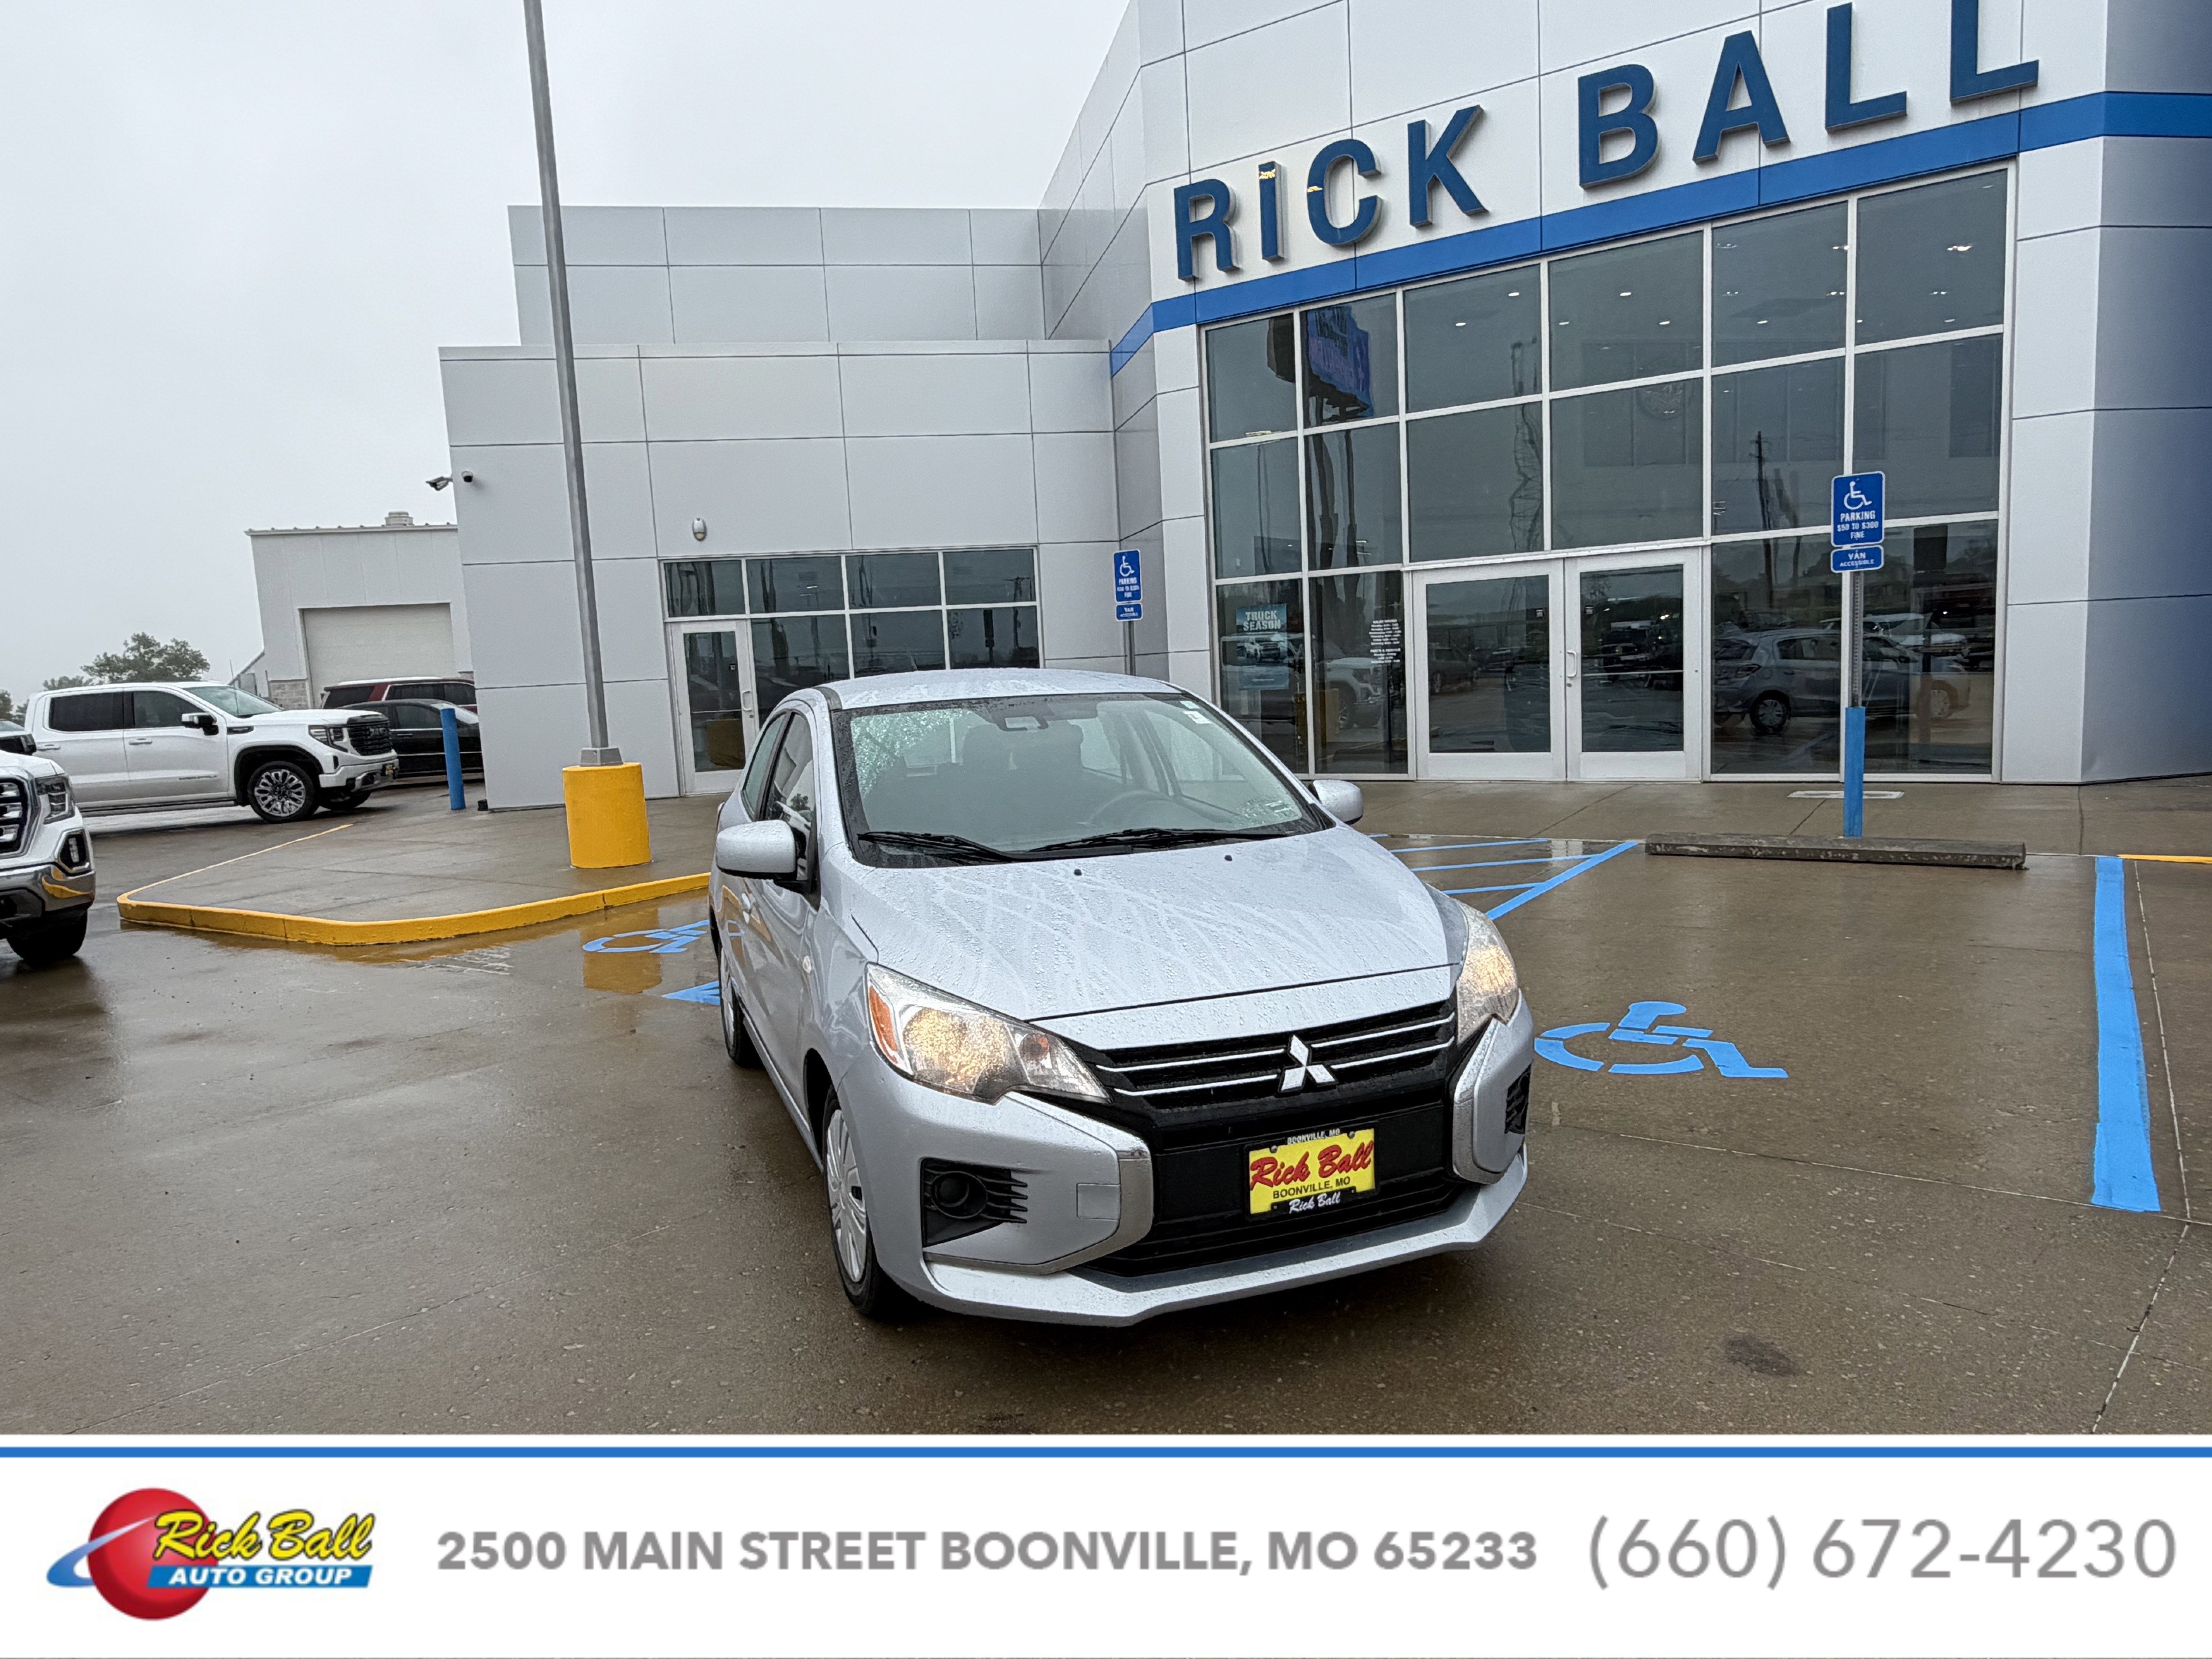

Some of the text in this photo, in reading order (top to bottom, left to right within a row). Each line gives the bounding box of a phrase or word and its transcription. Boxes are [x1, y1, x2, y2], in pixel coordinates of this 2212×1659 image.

[1173, 0, 2039, 280] RICK BALL
[1840, 510, 1875, 522] PARKING
[1837, 524, 1850, 532] $50
[1862, 521, 1879, 529] $300
[1245, 610, 1277, 621] TRUCK
[1243, 619, 1281, 631] SEASON
[1287, 1128, 1340, 1145] BOONVILLE, MO
[1250, 1140, 1374, 1191] Rick Ball
[1273, 1176, 1350, 1199] BOONVILLE, MO
[1289, 1192, 1341, 1214] Rick Ball
